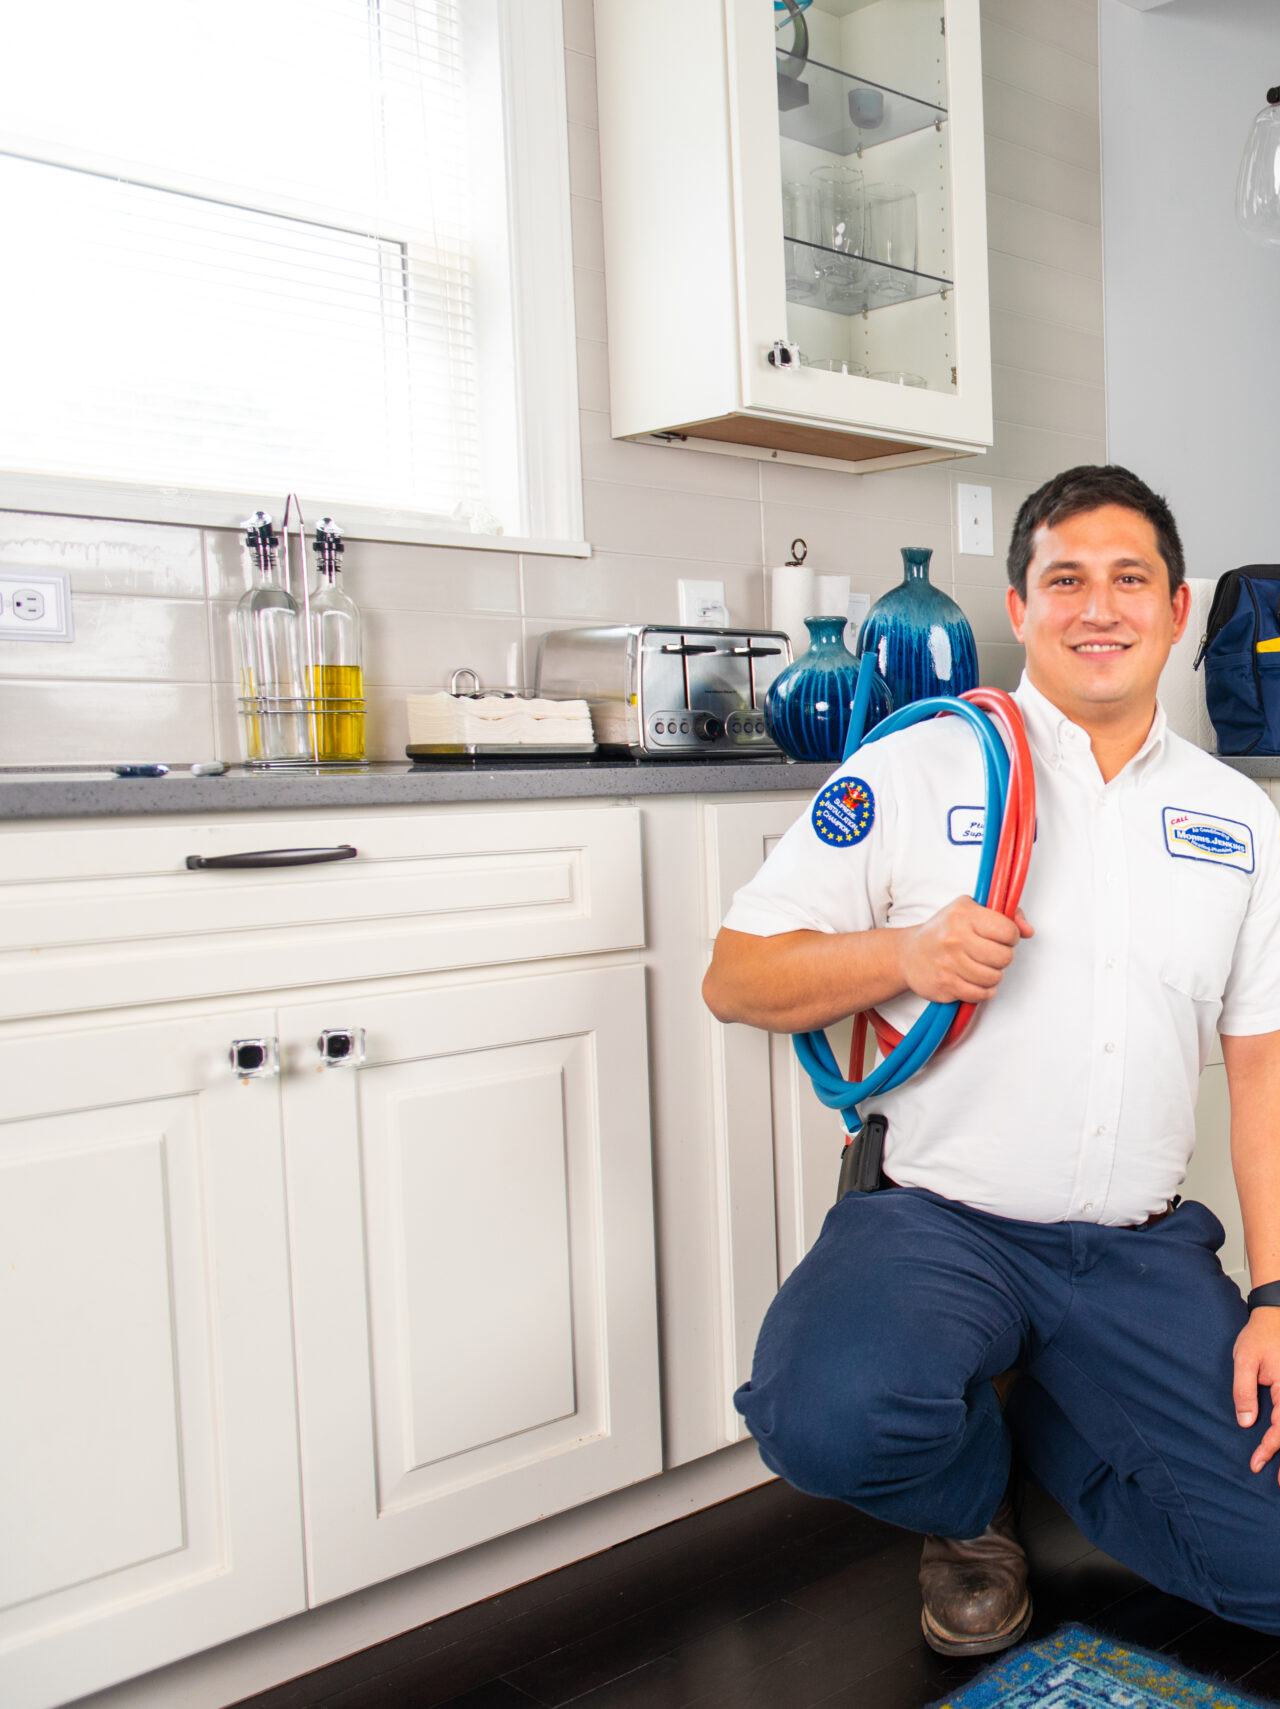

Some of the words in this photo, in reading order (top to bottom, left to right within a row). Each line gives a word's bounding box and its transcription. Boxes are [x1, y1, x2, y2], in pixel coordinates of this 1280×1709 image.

[824, 800, 858, 831] INSTALLATION
[833, 798, 857, 820] SUPREME
[1170, 815, 1188, 825] CALL
[822, 809, 850, 835] CHAMPION
